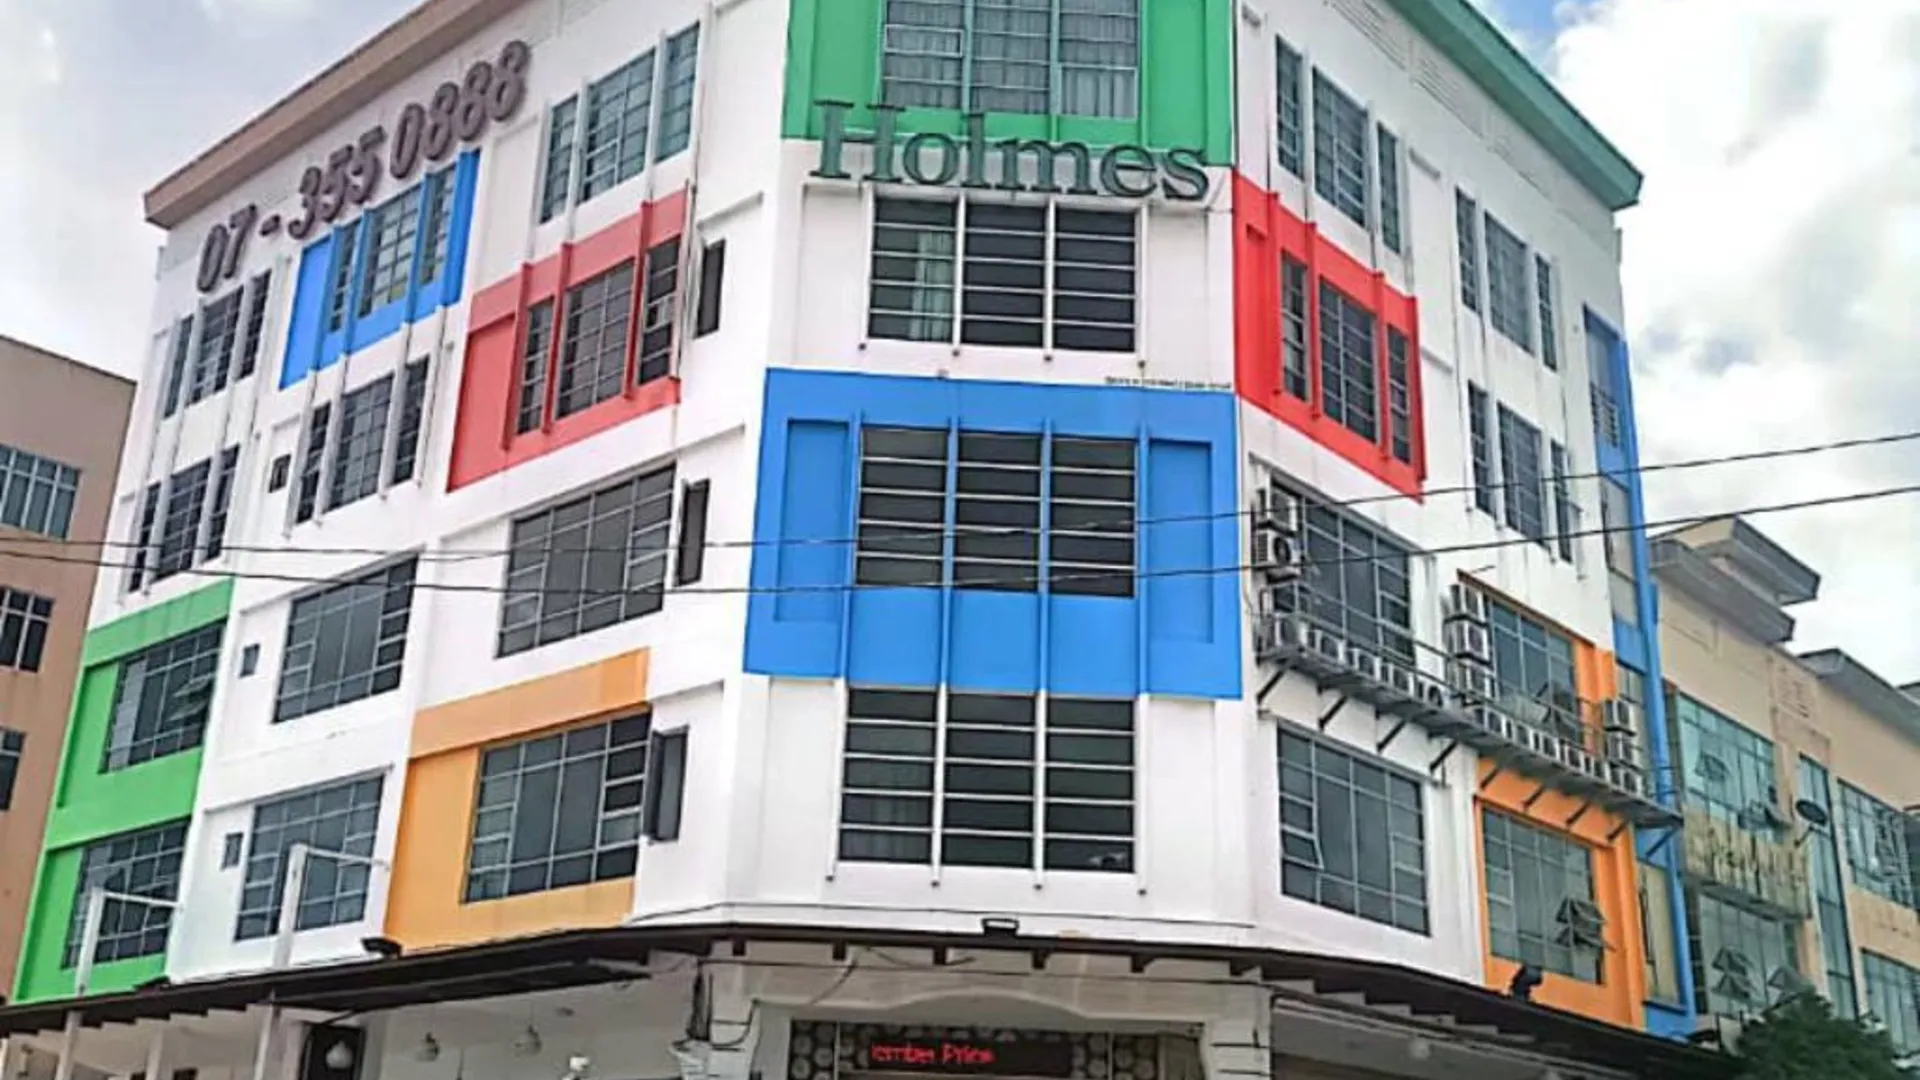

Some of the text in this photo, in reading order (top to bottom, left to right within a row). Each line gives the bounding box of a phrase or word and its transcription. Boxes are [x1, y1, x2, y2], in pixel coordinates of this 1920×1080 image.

[197, 205, 258, 293] 07
[288, 125, 387, 240] 355
[389, 40, 531, 179] 0888
[809, 101, 1210, 201] Holmes
